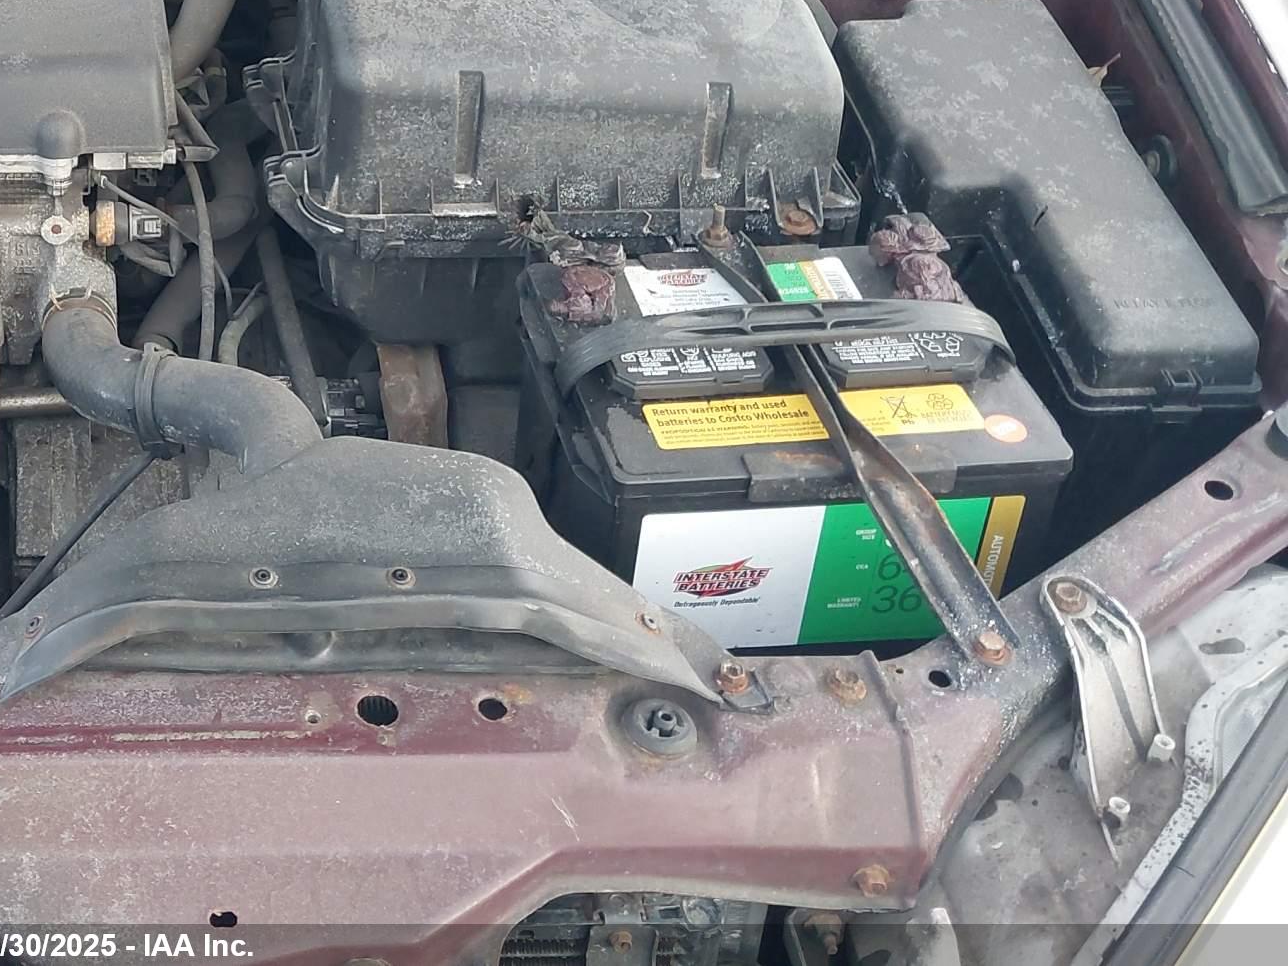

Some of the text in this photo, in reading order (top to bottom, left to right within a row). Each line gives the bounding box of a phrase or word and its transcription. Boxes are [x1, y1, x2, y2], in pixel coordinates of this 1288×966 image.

[651, 399, 787, 417] Return warranty and used
[657, 409, 809, 427] batteries to Costco Wholesale
[983, 535, 1004, 587] AUTOMOT
[676, 569, 768, 583] INTERSTATE
[678, 578, 758, 592] BATTERIES
